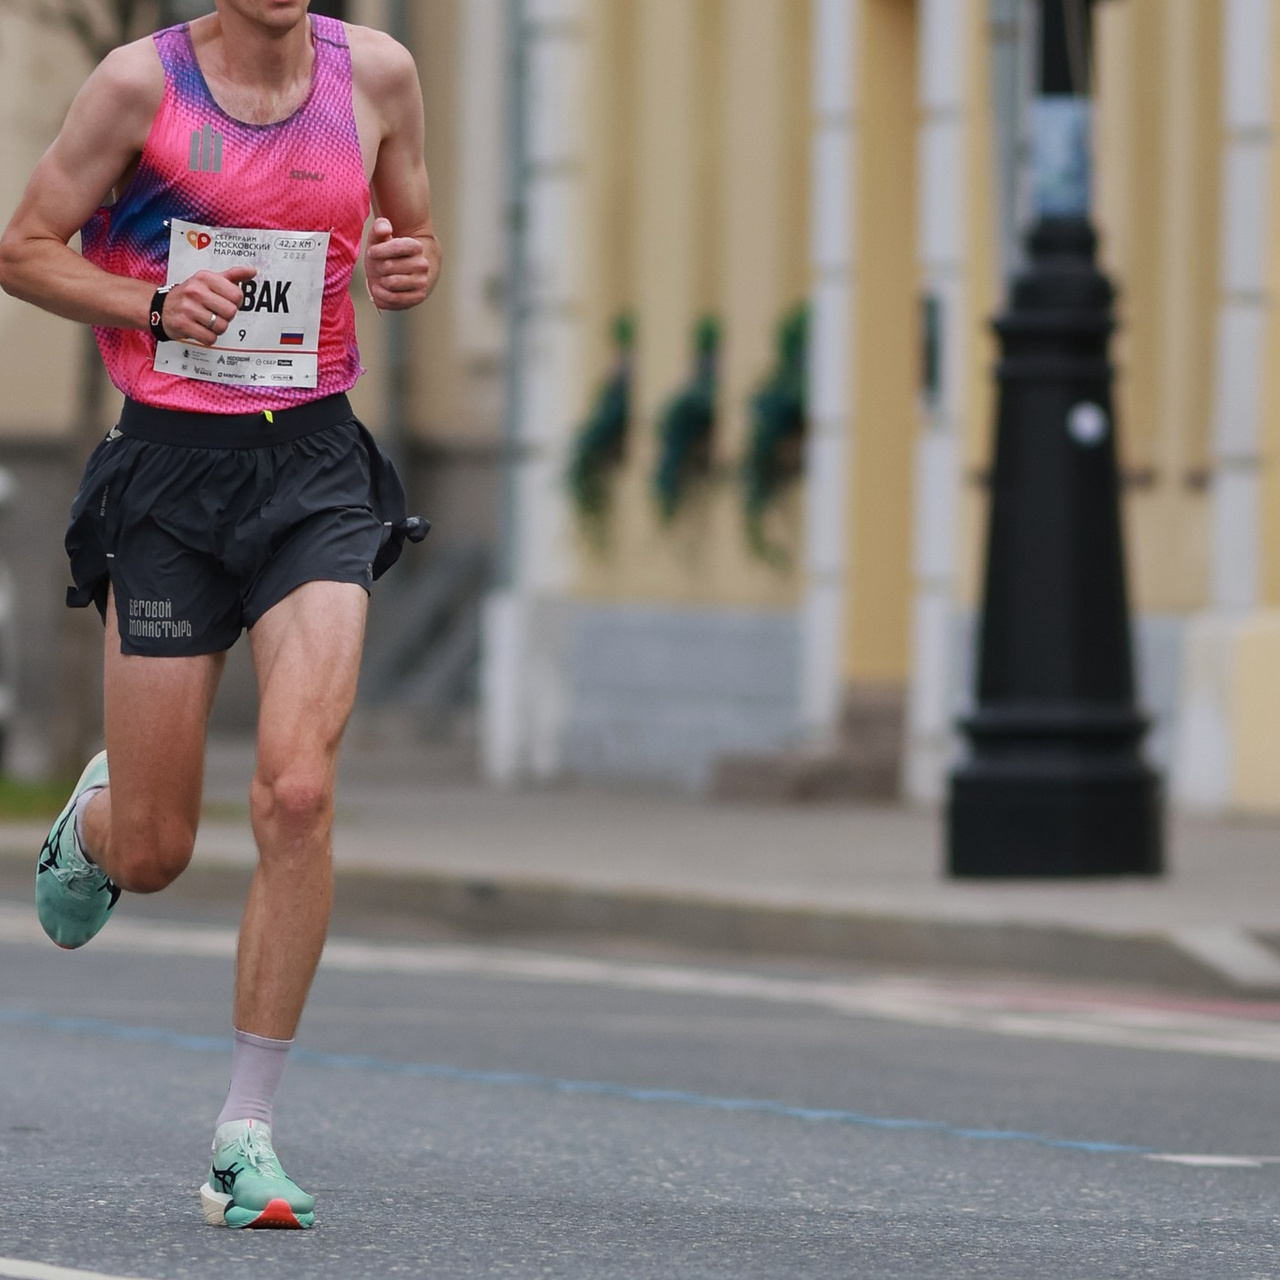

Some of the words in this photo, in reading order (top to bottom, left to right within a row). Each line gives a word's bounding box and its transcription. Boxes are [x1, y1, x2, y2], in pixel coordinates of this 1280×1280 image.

[214, 241, 271, 251] МОСКОВСКИЙ
[278, 240, 297, 248] 42,2
[213, 248, 256, 257] МАРАФОН
[237, 280, 292, 314] BAK
[238, 329, 246, 342] 9
